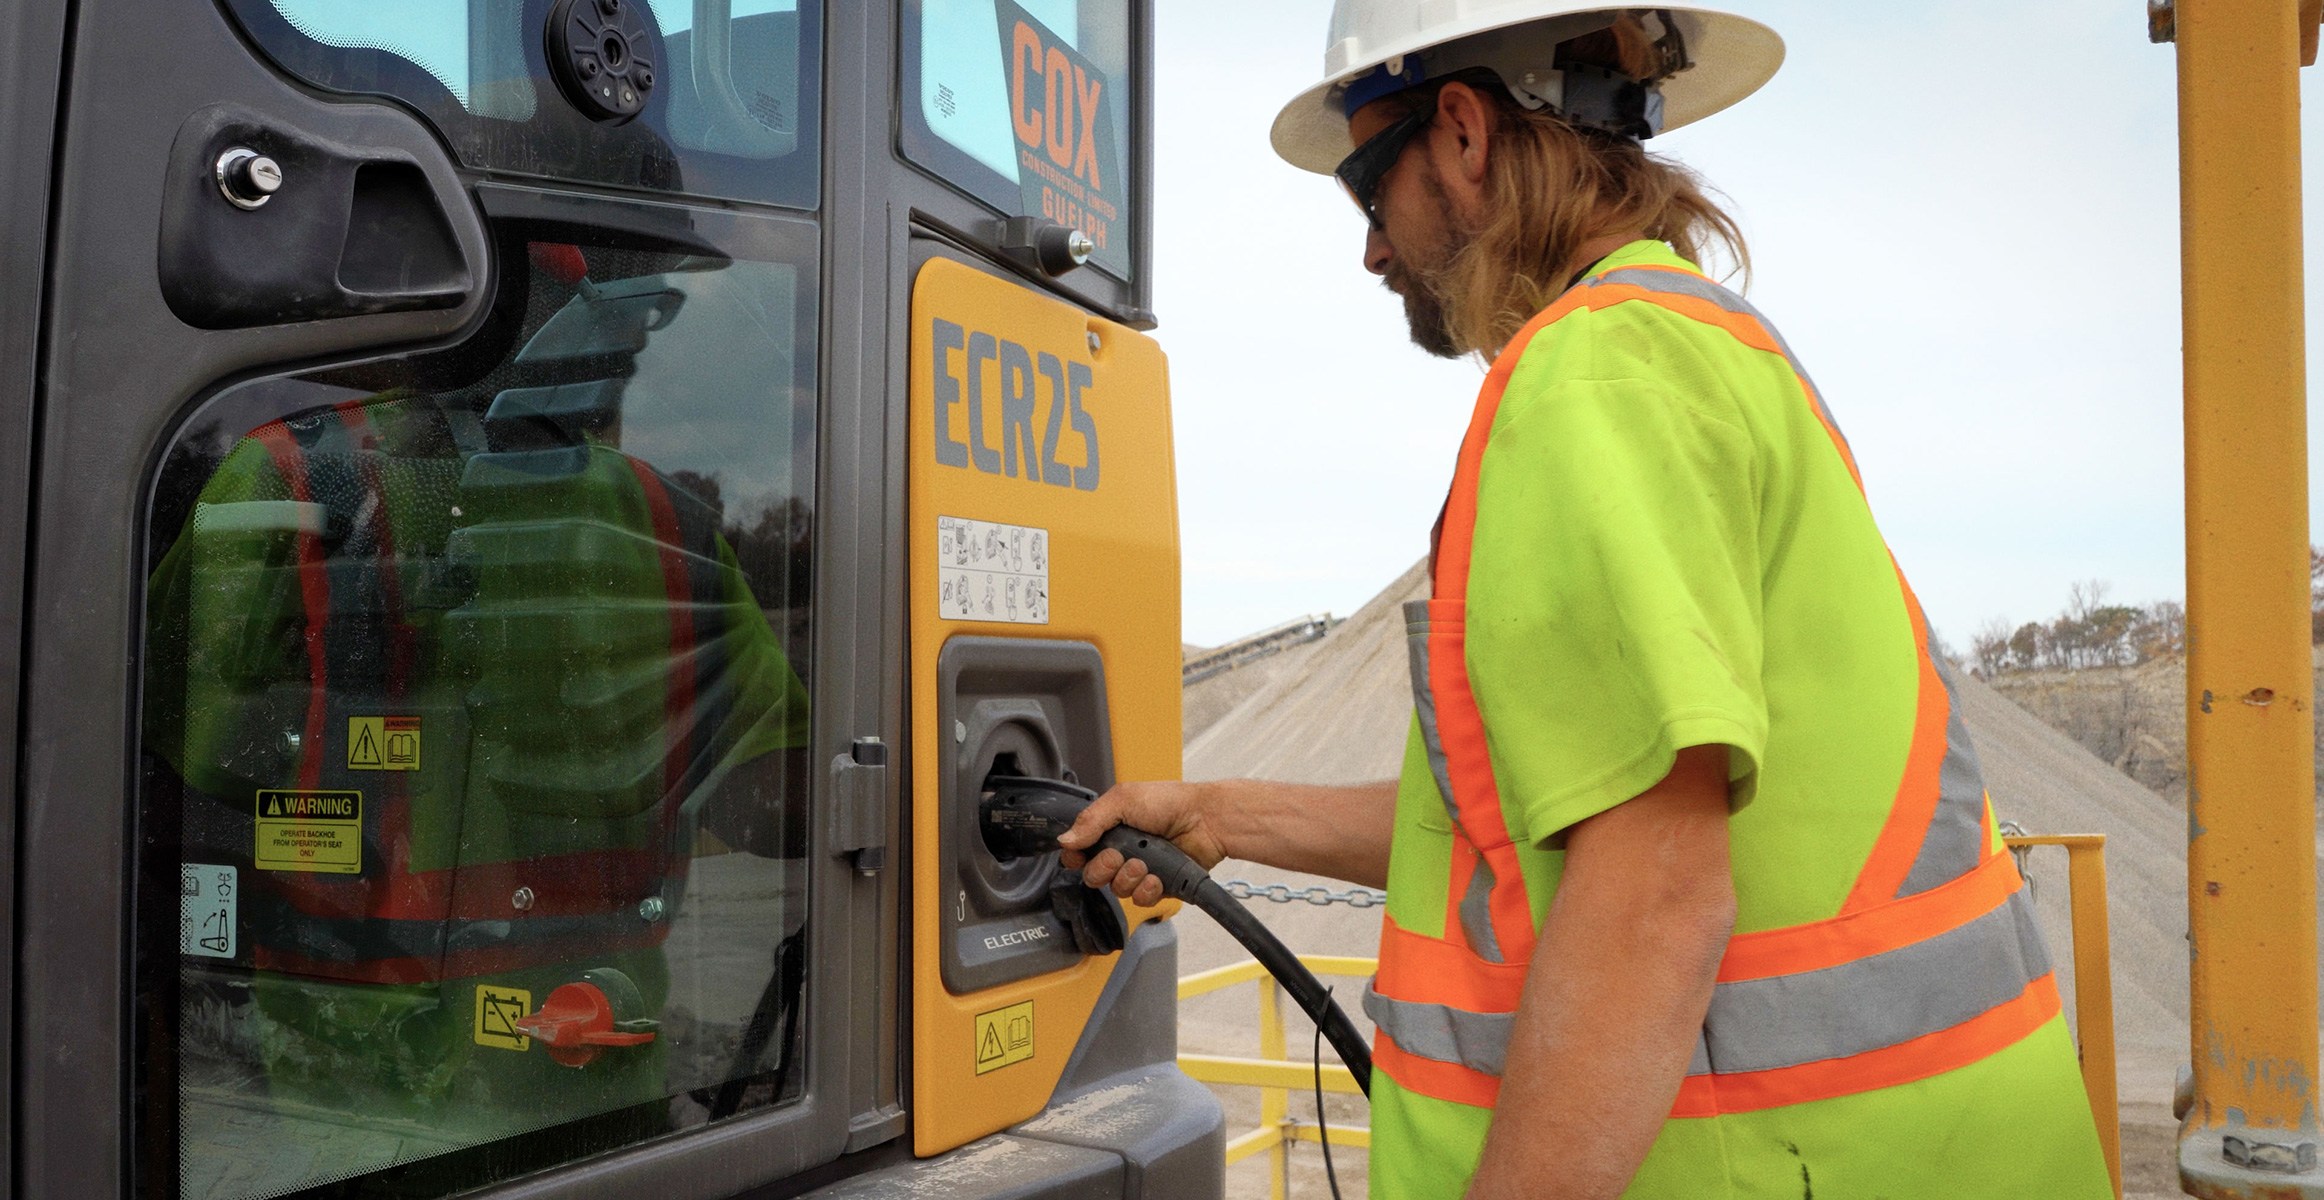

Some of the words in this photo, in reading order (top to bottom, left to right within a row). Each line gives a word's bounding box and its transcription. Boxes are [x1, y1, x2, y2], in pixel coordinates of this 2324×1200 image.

[1013, 20, 1101, 191] COX
[1022, 149, 1085, 202] CONSTRUCTION
[1087, 191, 1117, 221] LIMITED
[1043, 185, 1107, 250] GUELPH
[932, 317, 1100, 492] ECR25
[285, 797, 352, 815] WARNING
[273, 839, 290, 847] FROM
[291, 840, 327, 848] OPERATOR'S
[328, 840, 343, 849] SEAT
[280, 829, 306, 838] OPERATE
[307, 830, 336, 839] BACKHOE
[300, 849, 315, 857] ONLY
[984, 926, 1050, 950] ELECTRIC
